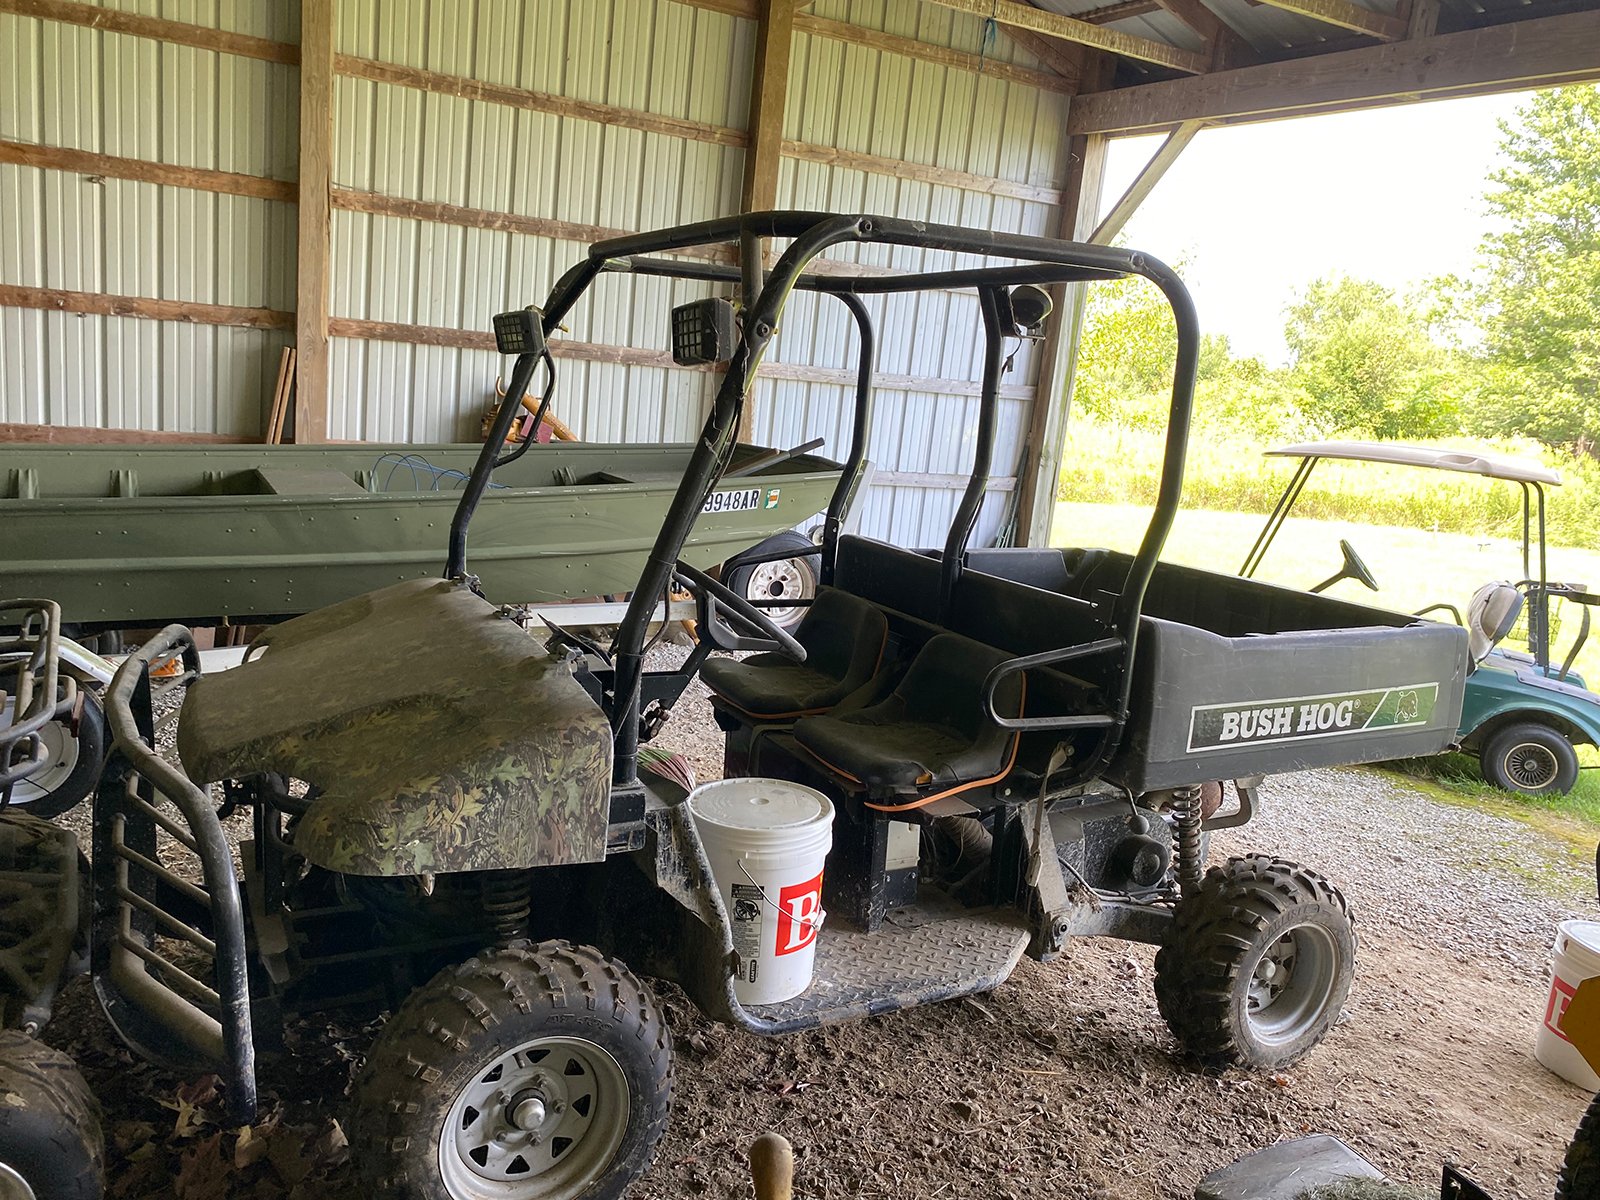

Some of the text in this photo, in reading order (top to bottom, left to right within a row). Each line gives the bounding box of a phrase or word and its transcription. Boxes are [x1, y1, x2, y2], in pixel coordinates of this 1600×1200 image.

[704, 490, 760, 512] 9948AR
[1219, 700, 1354, 741] BUSH HOG
